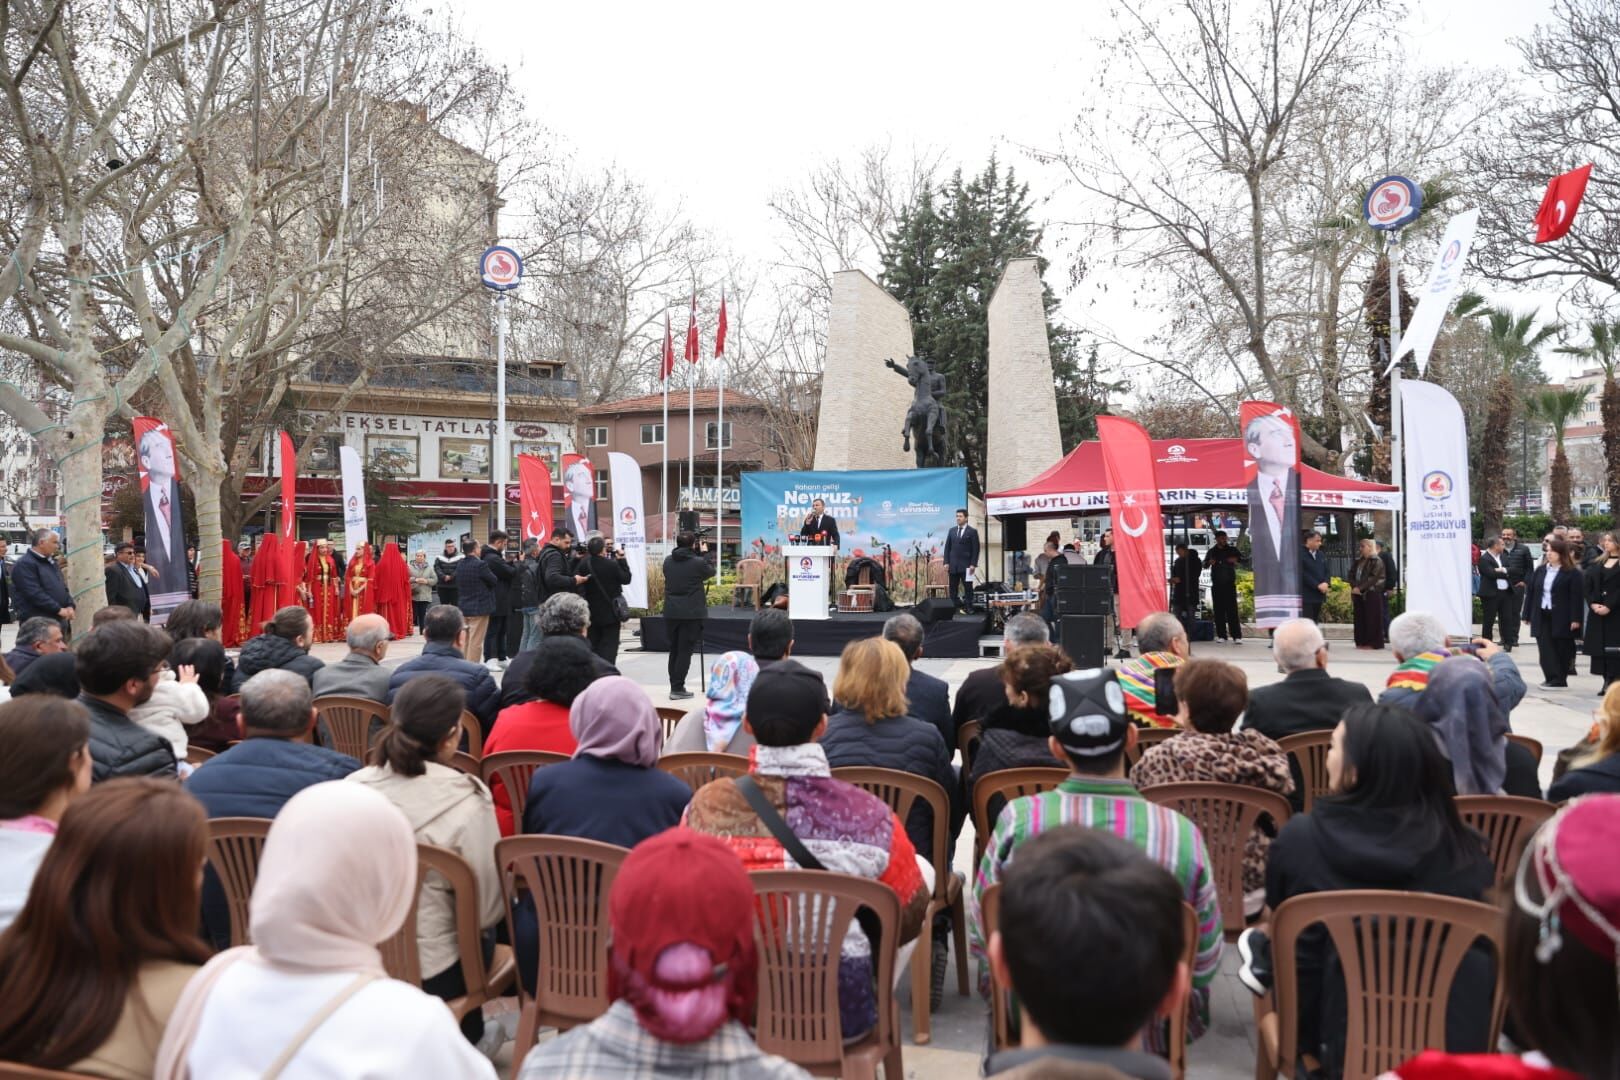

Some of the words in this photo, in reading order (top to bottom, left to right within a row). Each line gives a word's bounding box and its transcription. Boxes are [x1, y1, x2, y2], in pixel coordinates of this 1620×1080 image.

[784, 490, 852, 505] Nevruz
[1022, 496, 1081, 509] MUTLU
[776, 504, 859, 519] Bayamı
